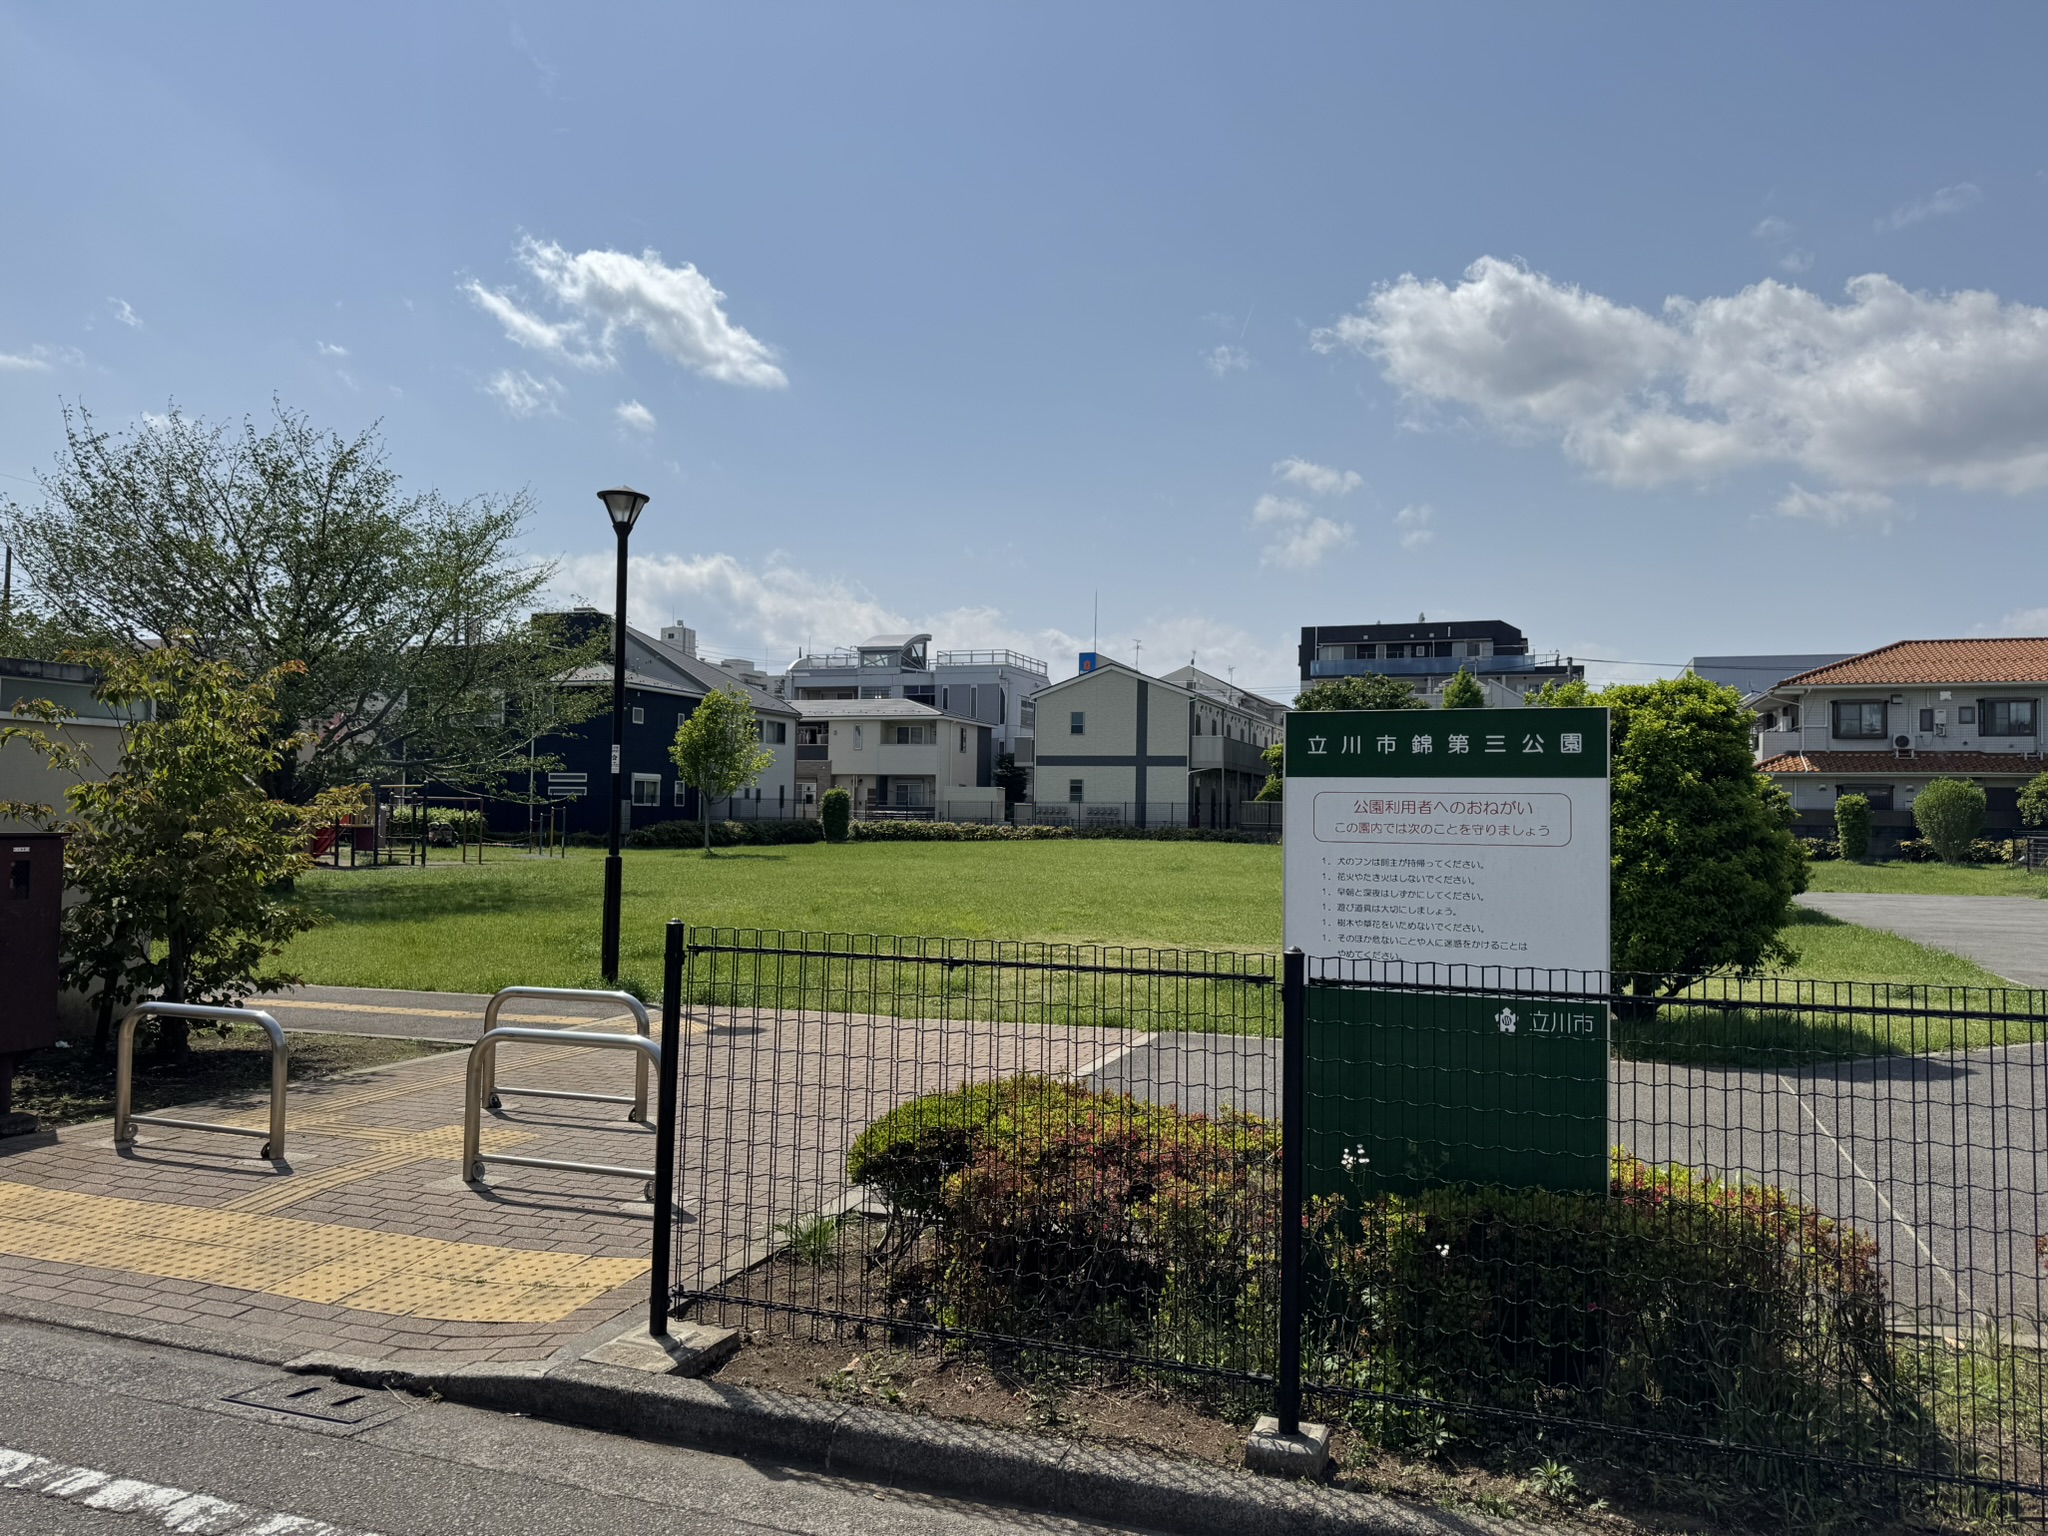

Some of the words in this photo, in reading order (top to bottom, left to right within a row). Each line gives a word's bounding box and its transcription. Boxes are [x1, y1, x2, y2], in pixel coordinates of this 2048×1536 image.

[1307, 733, 1582, 755] 立川市錦第三公園
[1353, 799, 1533, 816] 公園利用者へのおねがい
[1334, 822, 1550, 838] この園内では次のことを守りましょう
[1529, 1010, 1595, 1035] 立川市
